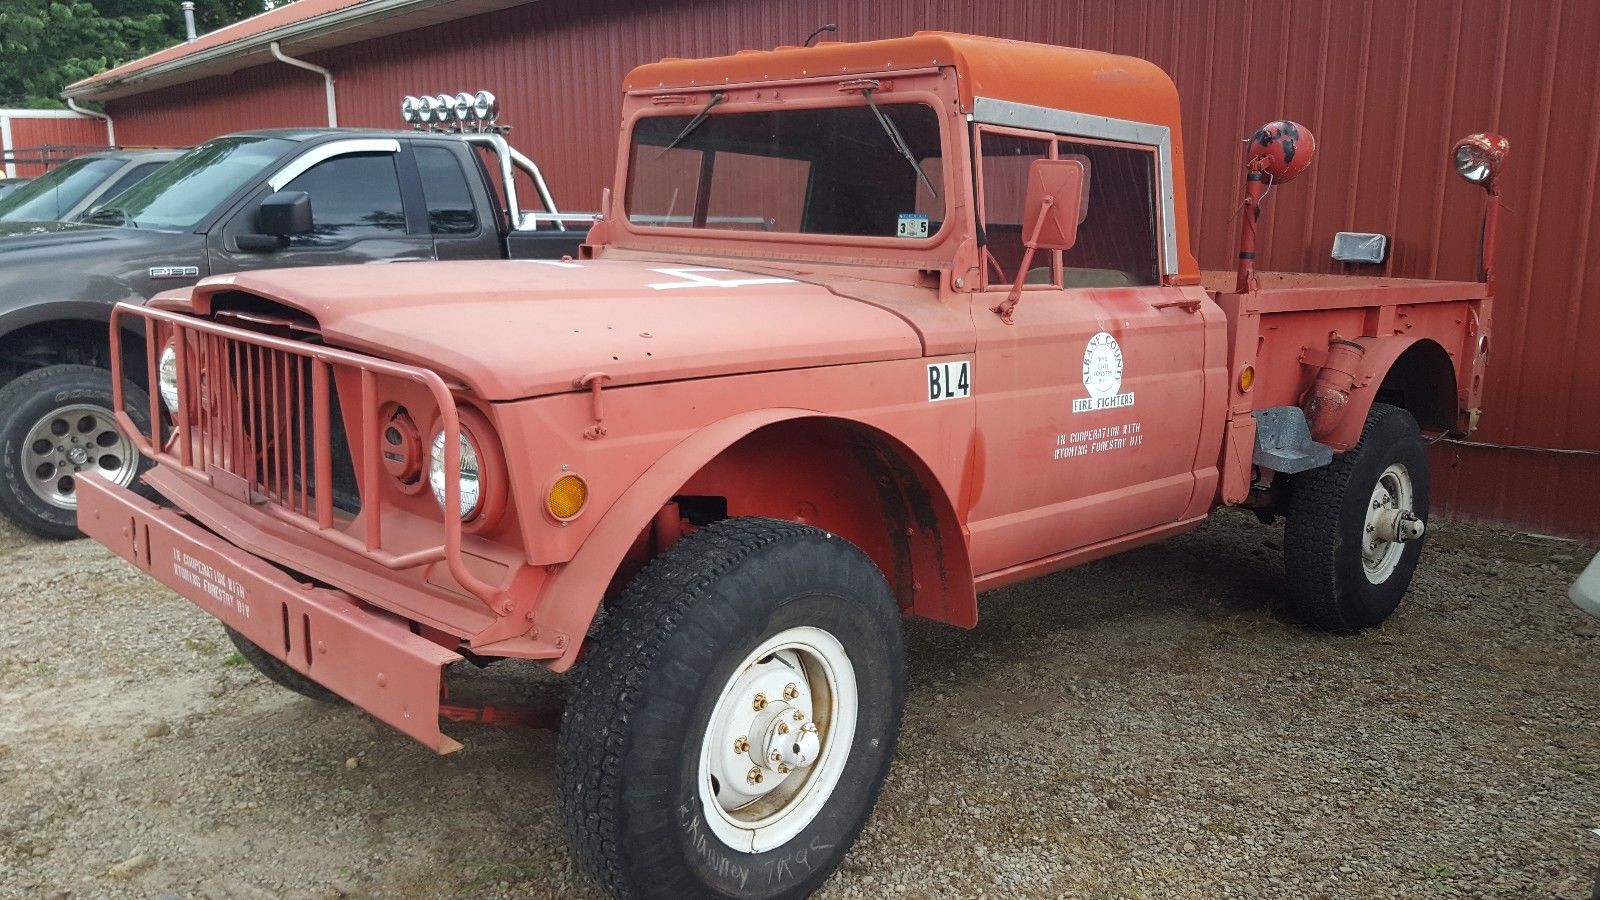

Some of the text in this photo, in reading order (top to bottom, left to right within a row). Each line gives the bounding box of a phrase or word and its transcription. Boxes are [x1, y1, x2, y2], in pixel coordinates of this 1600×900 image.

[900, 222, 927, 233] 3 5
[1083, 335, 1122, 385] ALBANY COUNTY
[929, 363, 969, 400] BL4
[1074, 395, 1133, 411] FIRE FIGHTERS
[1054, 435, 1143, 460] WYOMING FORESTRY DIV
[1056, 422, 1141, 446] IN COOPERATION WITH
[173, 547, 245, 599] IN COOPERATION WITH
[174, 562, 201, 589] WYOMING
[203, 578, 234, 607] FORESTRY
